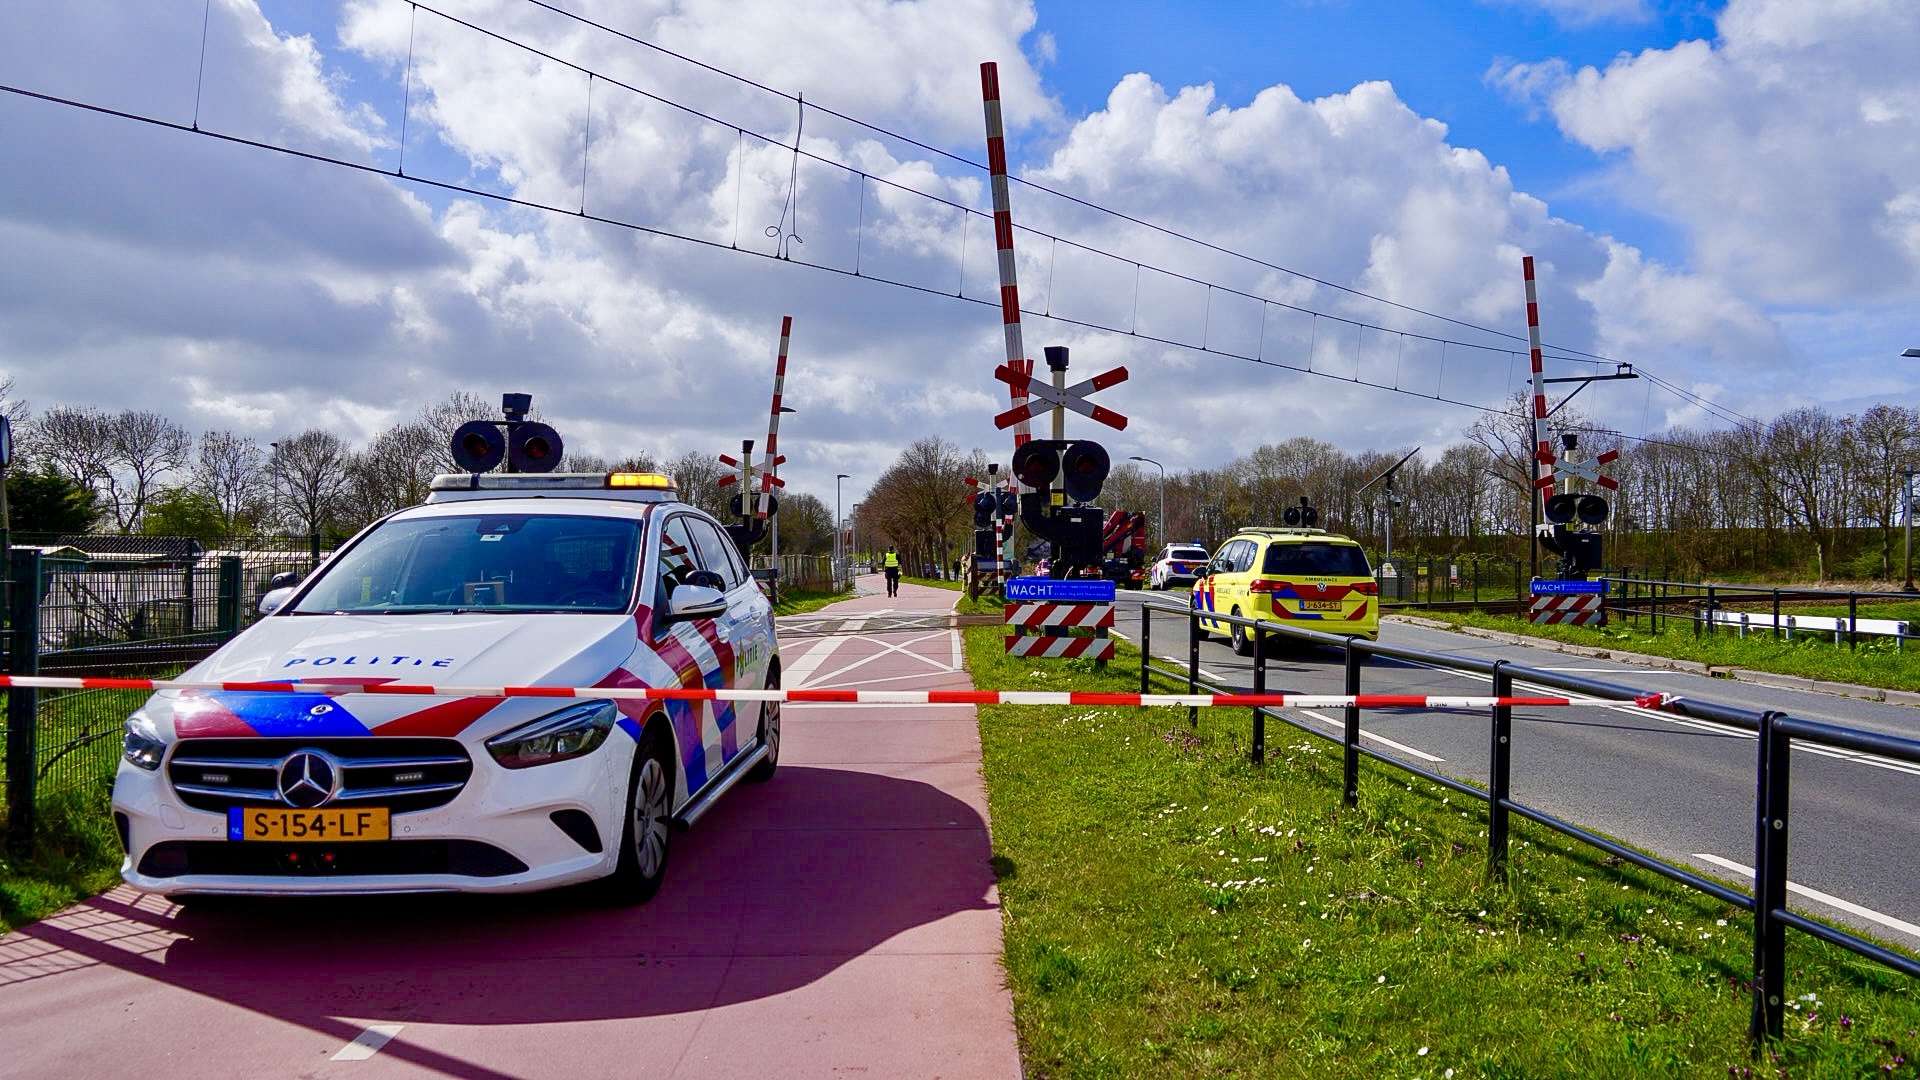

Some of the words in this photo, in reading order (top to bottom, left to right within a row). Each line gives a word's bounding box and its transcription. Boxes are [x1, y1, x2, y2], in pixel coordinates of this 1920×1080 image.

[1010, 585, 1053, 596] WACHT
[1533, 583, 1566, 591] WACHT
[1306, 601, 1339, 609] J-634-ST
[283, 656, 454, 668] POLITIE
[254, 812, 371, 837] S-154-LF
[231, 827, 242, 835] NL
